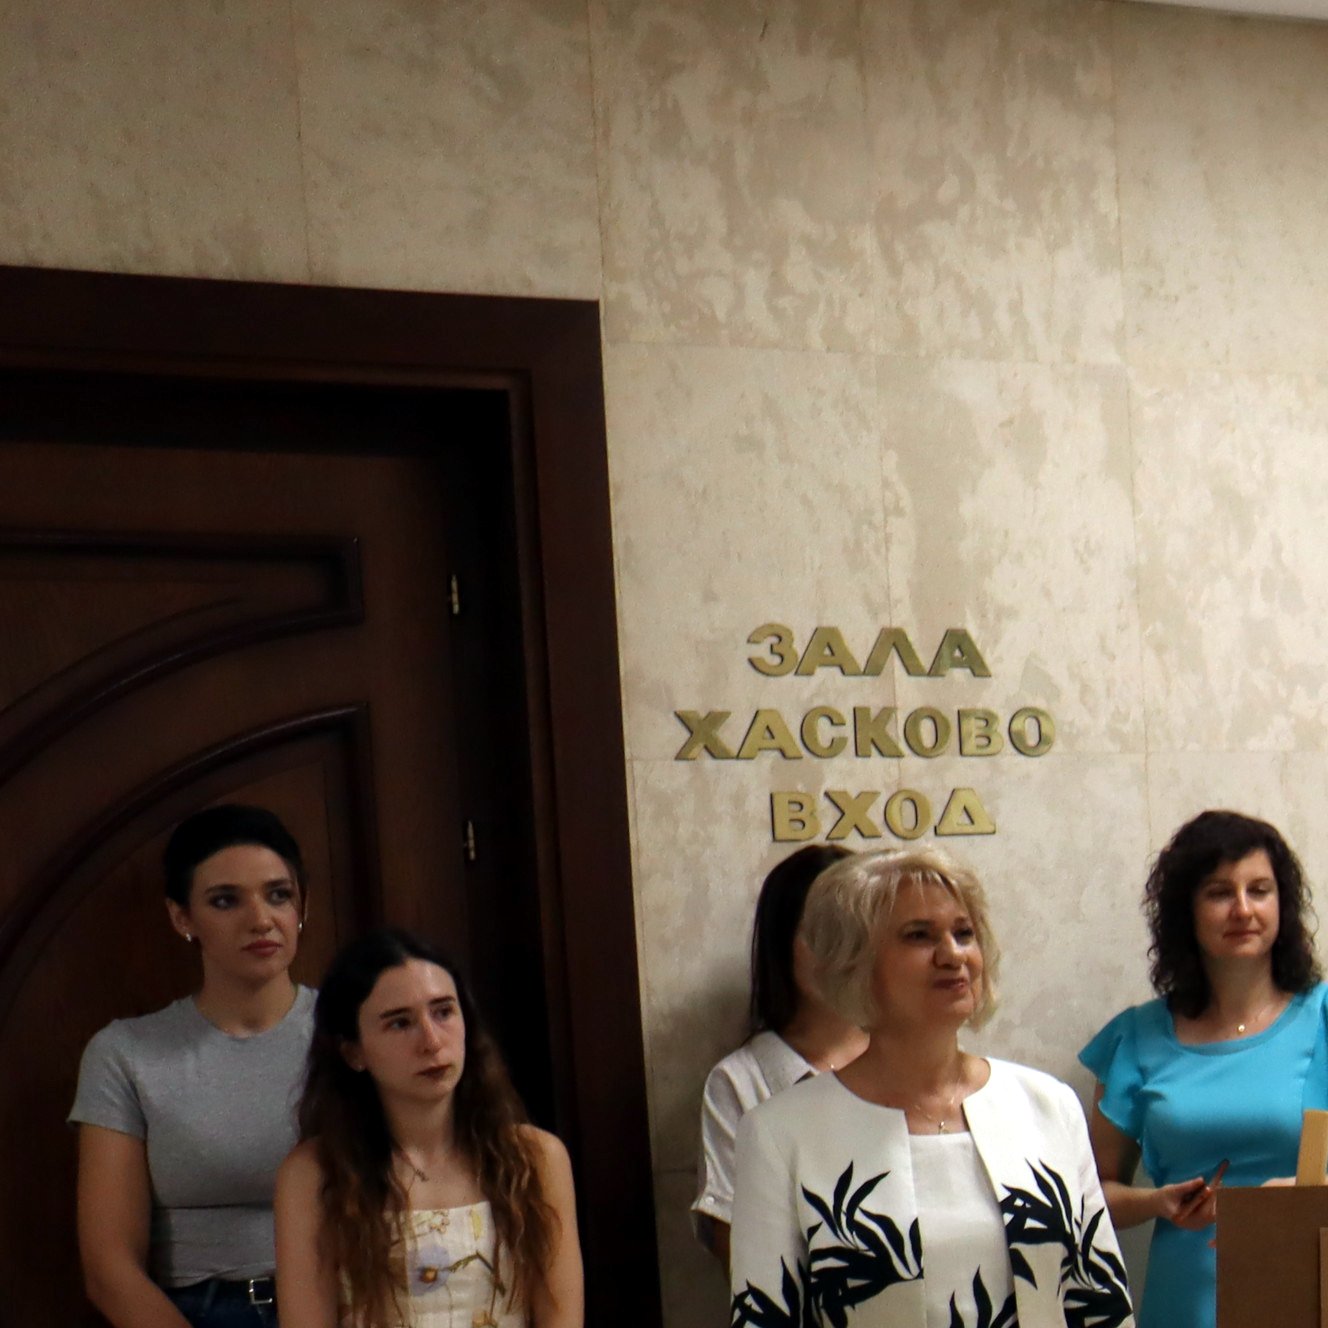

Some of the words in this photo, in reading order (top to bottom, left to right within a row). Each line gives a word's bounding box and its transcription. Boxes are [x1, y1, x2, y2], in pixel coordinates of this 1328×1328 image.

[746, 623, 992, 677] ЗАЛА
[673, 706, 1056, 760] ХАСКОВО
[769, 788, 997, 842] ВХОД
